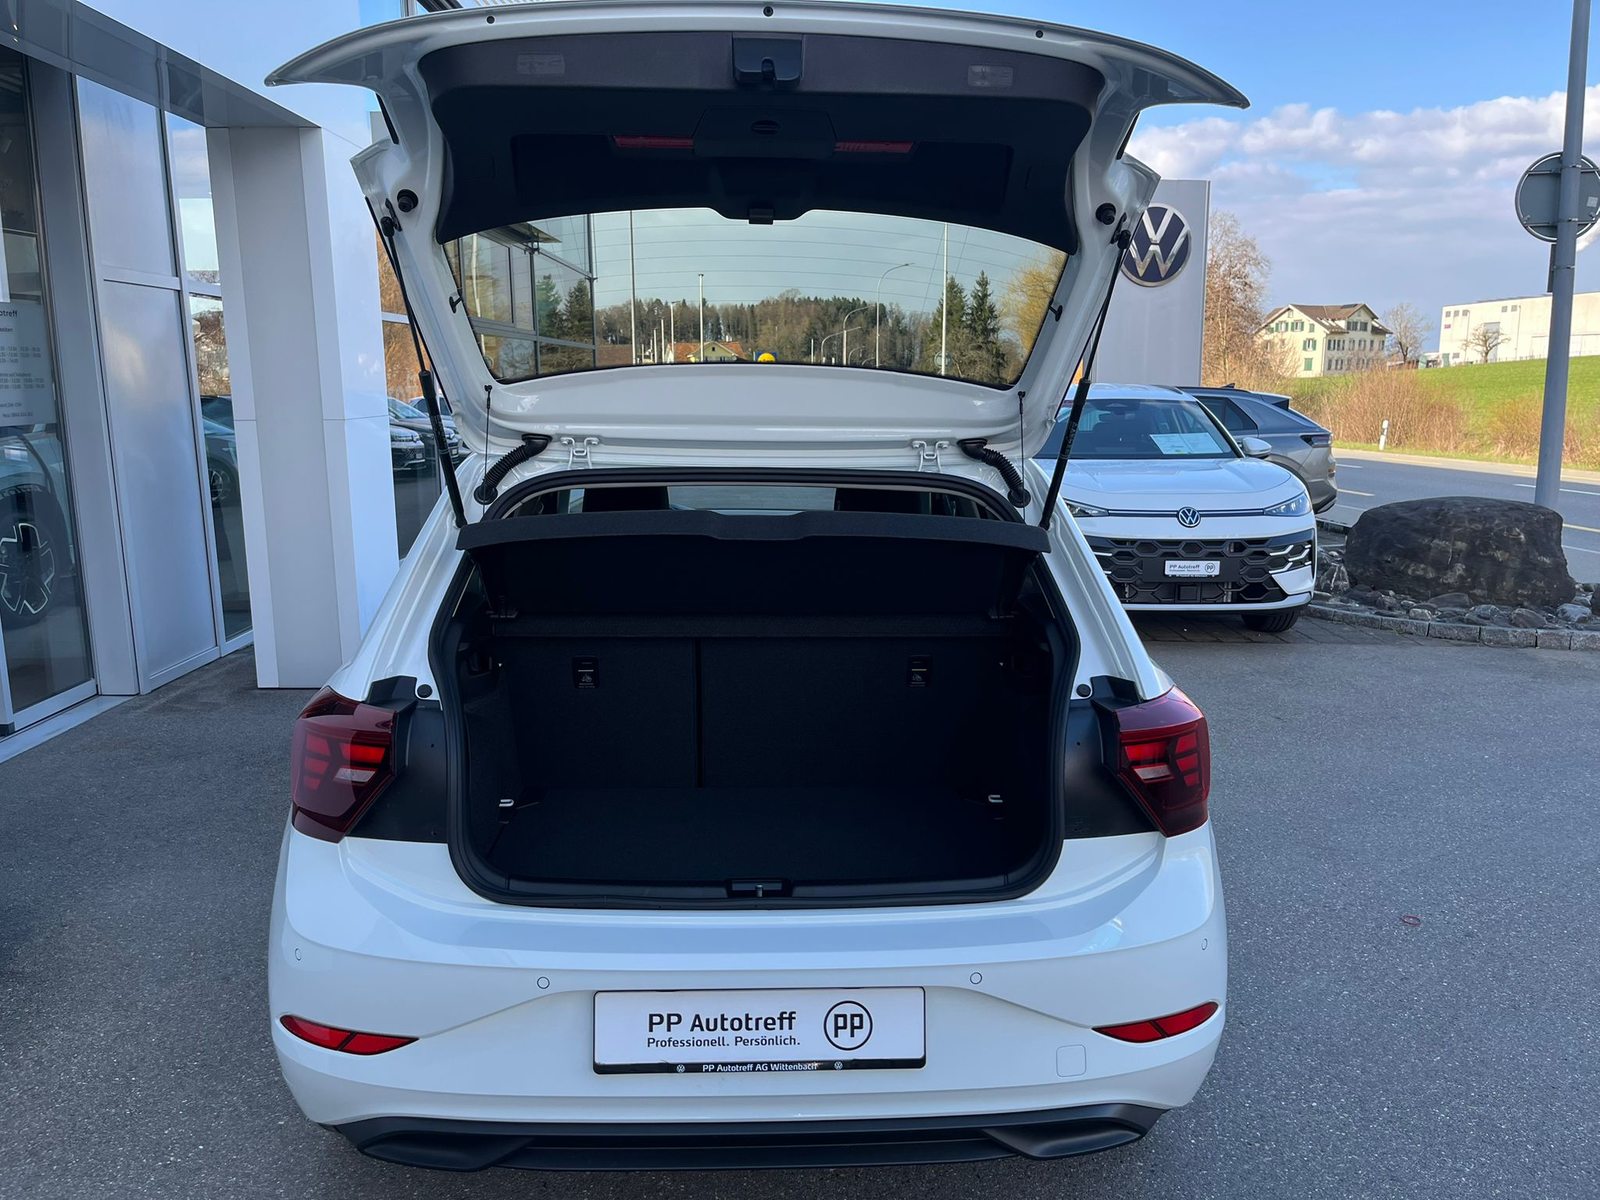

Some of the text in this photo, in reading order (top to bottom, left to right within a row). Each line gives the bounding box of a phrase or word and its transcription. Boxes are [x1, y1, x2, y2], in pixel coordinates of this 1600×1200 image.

[648, 1011, 796, 1032] PP Autotreff
[647, 1035, 800, 1048] Professionell. Persönlich.
[702, 1064, 714, 1072] PP
[716, 1063, 754, 1072] Autotreff
[755, 1063, 768, 1071] AG
[770, 1061, 818, 1071] Wittenbach
